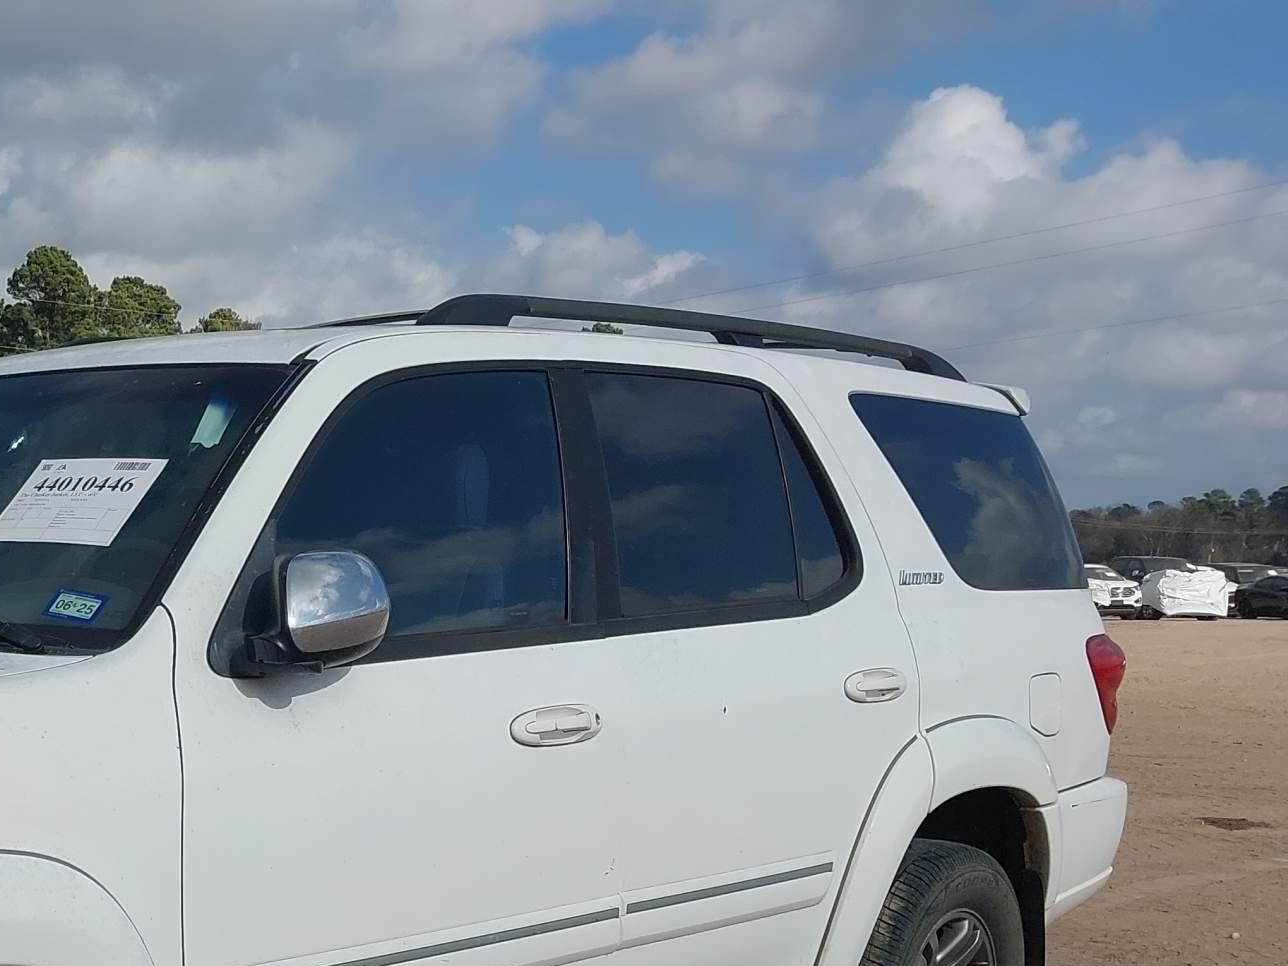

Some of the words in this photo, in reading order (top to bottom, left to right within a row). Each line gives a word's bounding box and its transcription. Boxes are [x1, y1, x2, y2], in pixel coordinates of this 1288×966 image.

[34, 476, 140, 492] 44010446
[55, 599, 72, 611] 06
[76, 602, 96, 615] 25
